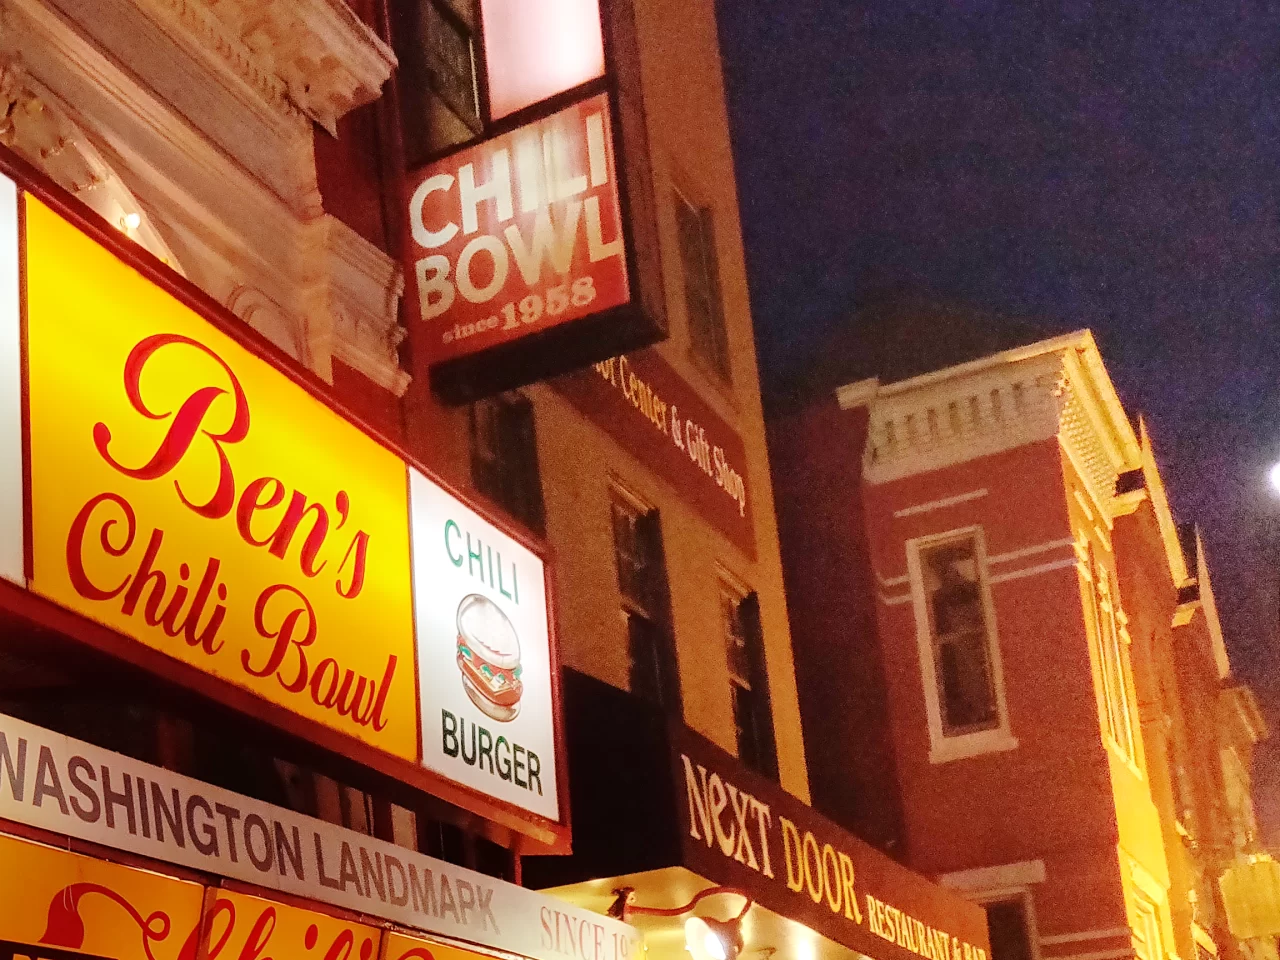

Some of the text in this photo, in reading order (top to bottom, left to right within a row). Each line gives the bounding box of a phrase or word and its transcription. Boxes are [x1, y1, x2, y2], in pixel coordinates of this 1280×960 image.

[410, 113, 609, 249] CHILI
[415, 196, 620, 321] BOWL
[499, 276, 597, 332] 1958
[93, 333, 370, 599] Ben's
[713, 445, 745, 517] Shop
[66, 492, 397, 732] Chili Bowl
[444, 519, 519, 605] CHILI
[441, 709, 543, 796] BURGER
[313, 832, 503, 936] LANDMARK
[779, 815, 862, 925] DOOR
